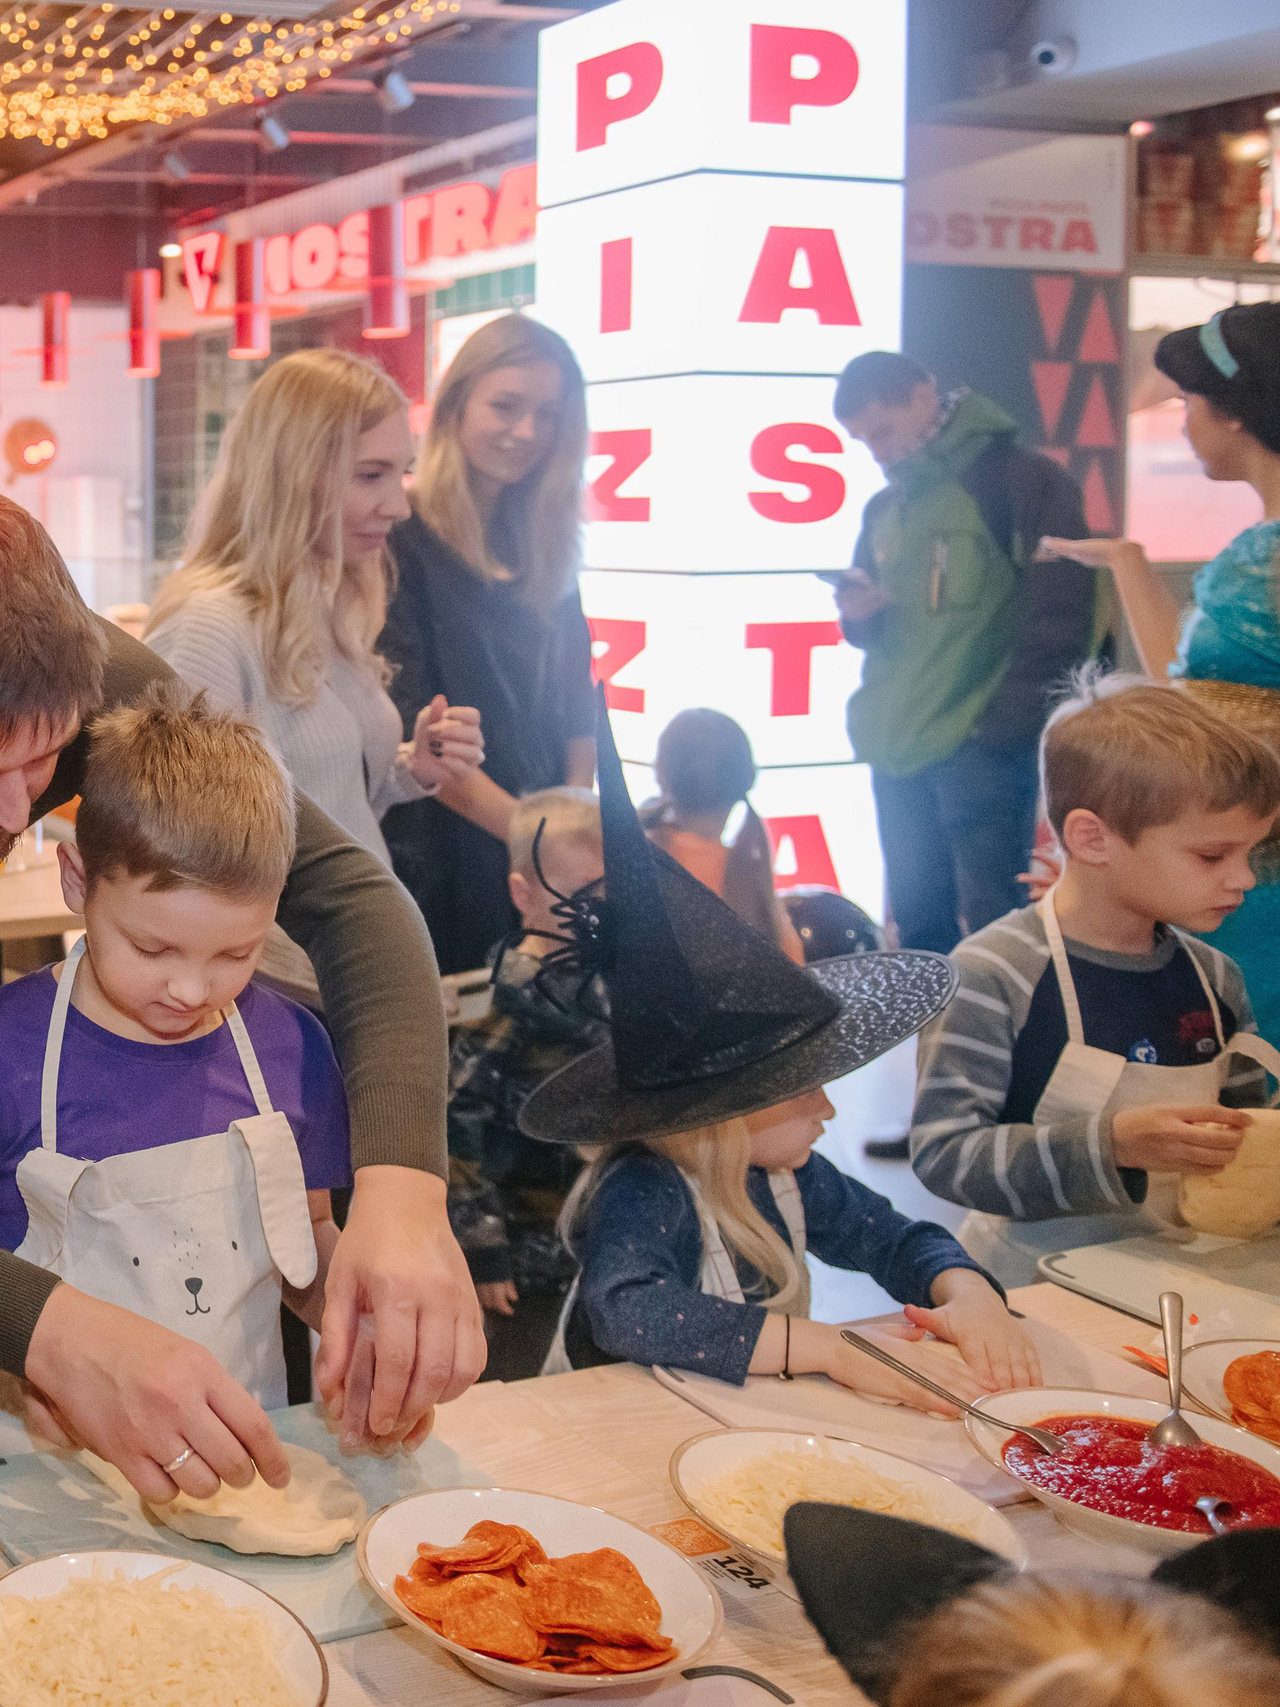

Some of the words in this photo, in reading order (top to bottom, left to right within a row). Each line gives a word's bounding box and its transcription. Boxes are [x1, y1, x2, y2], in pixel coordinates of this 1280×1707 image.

[576, 40, 663, 714] PIZZ
[738, 23, 862, 893] PASTA
[712, 1555, 770, 1589] 124
